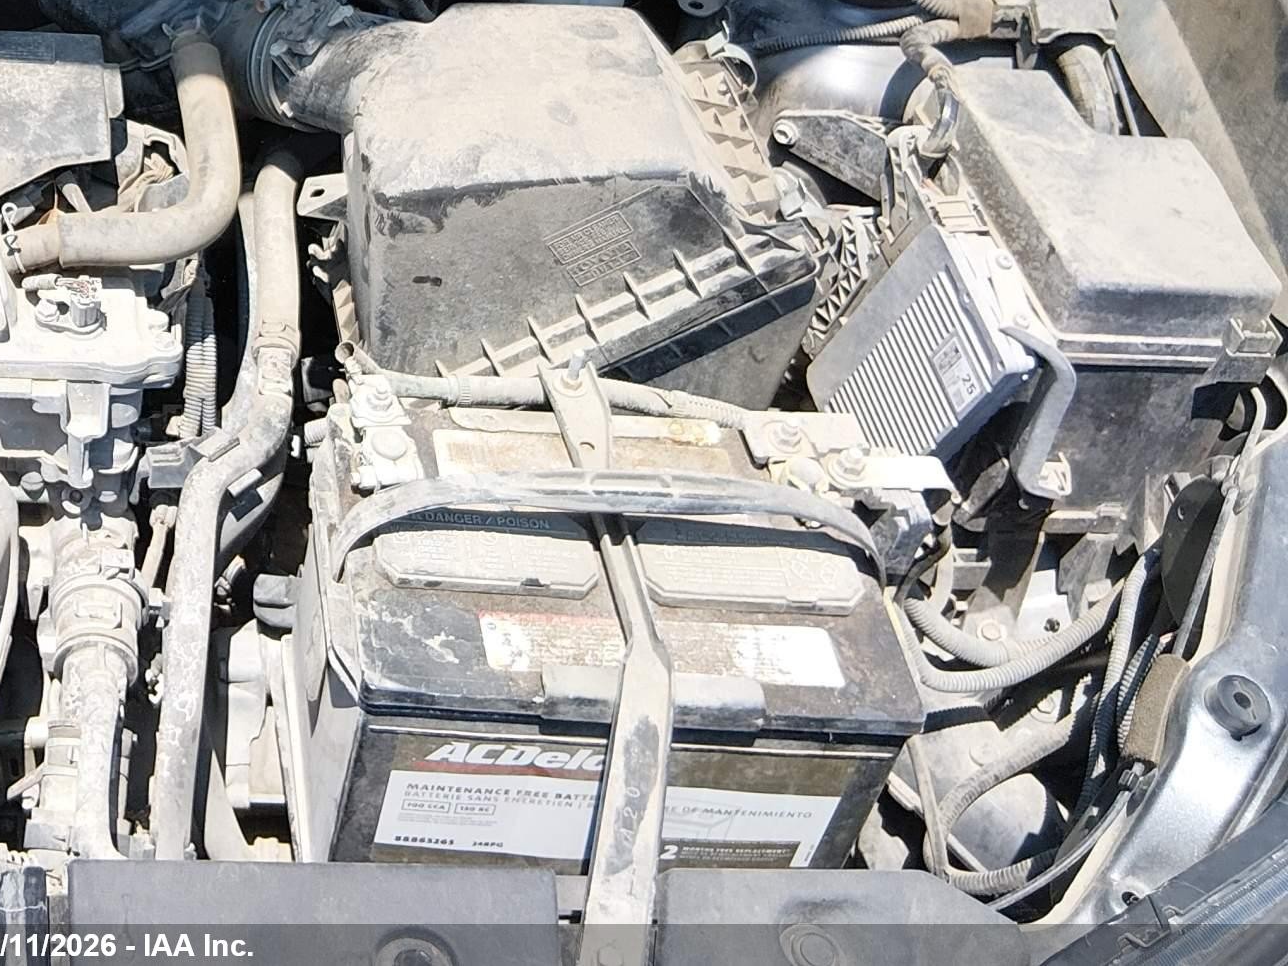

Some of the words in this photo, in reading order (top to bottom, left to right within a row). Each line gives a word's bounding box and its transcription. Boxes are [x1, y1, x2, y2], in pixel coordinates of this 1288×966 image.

[425, 512, 482, 525] DANGER
[497, 516, 550, 530] POISON
[425, 741, 605, 771] ACDelc
[404, 791, 462, 802] BATTERIE
[467, 794, 499, 803] SANS
[406, 782, 511, 796] MAINTENANCE
[515, 789, 549, 799] FREE
[554, 792, 597, 802] BATTE
[703, 807, 813, 819] MANTENIMIENTO
